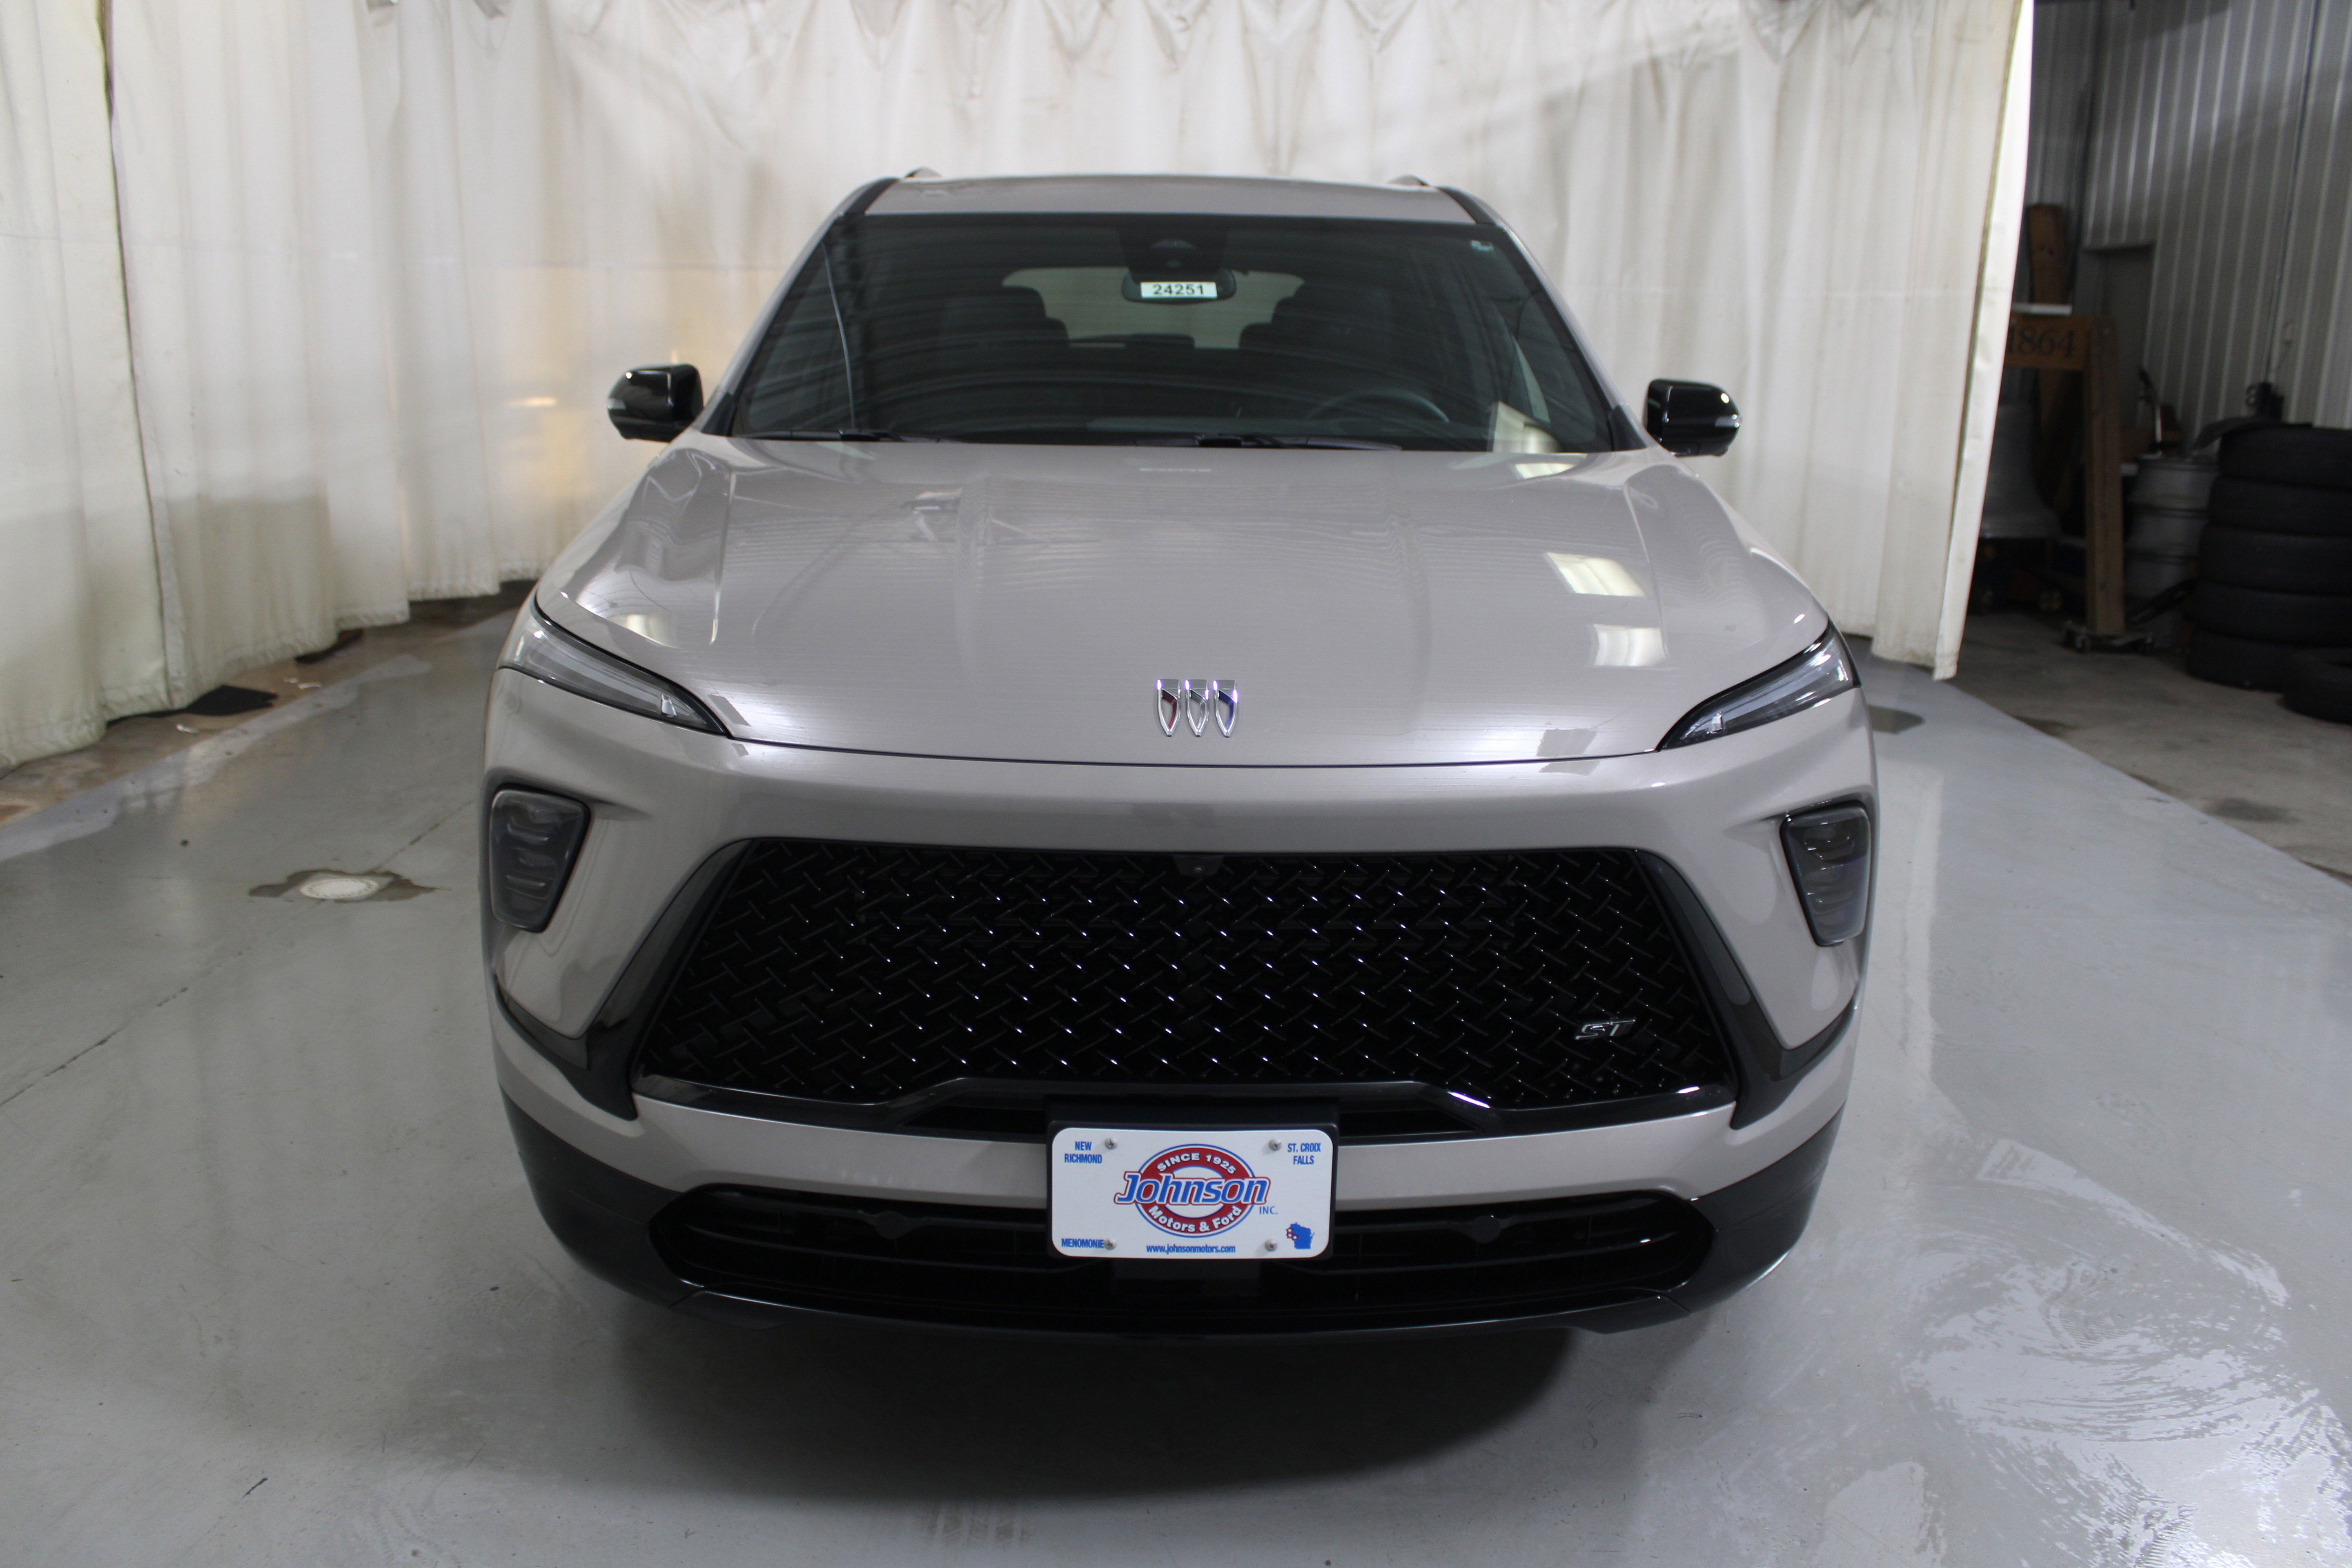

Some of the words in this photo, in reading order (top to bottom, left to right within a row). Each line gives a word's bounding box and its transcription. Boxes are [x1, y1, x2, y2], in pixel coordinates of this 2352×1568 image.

[1153, 284, 1204, 295] 24251
[1575, 1018, 1636, 1040] ST
[1075, 1142, 1091, 1151] NEW
[1287, 1143, 1298, 1152] ST.
[1301, 1143, 1321, 1152] CROIX
[1064, 1154, 1102, 1163] RICHMOND
[1294, 1156, 1314, 1165] FALLS
[1157, 1153, 1200, 1172] SINCE
[1206, 1155, 1236, 1174] 1925
[1115, 1171, 1270, 1205] Johnson
[1260, 1207, 1277, 1215] INC.
[1149, 1206, 1195, 1232] Motors
[1199, 1221, 1210, 1233] &
[1212, 1205, 1243, 1229] Ford
[1062, 1239, 1104, 1248] MENOMONIE
[1147, 1245, 1235, 1254] www.johnsonmotors.com
